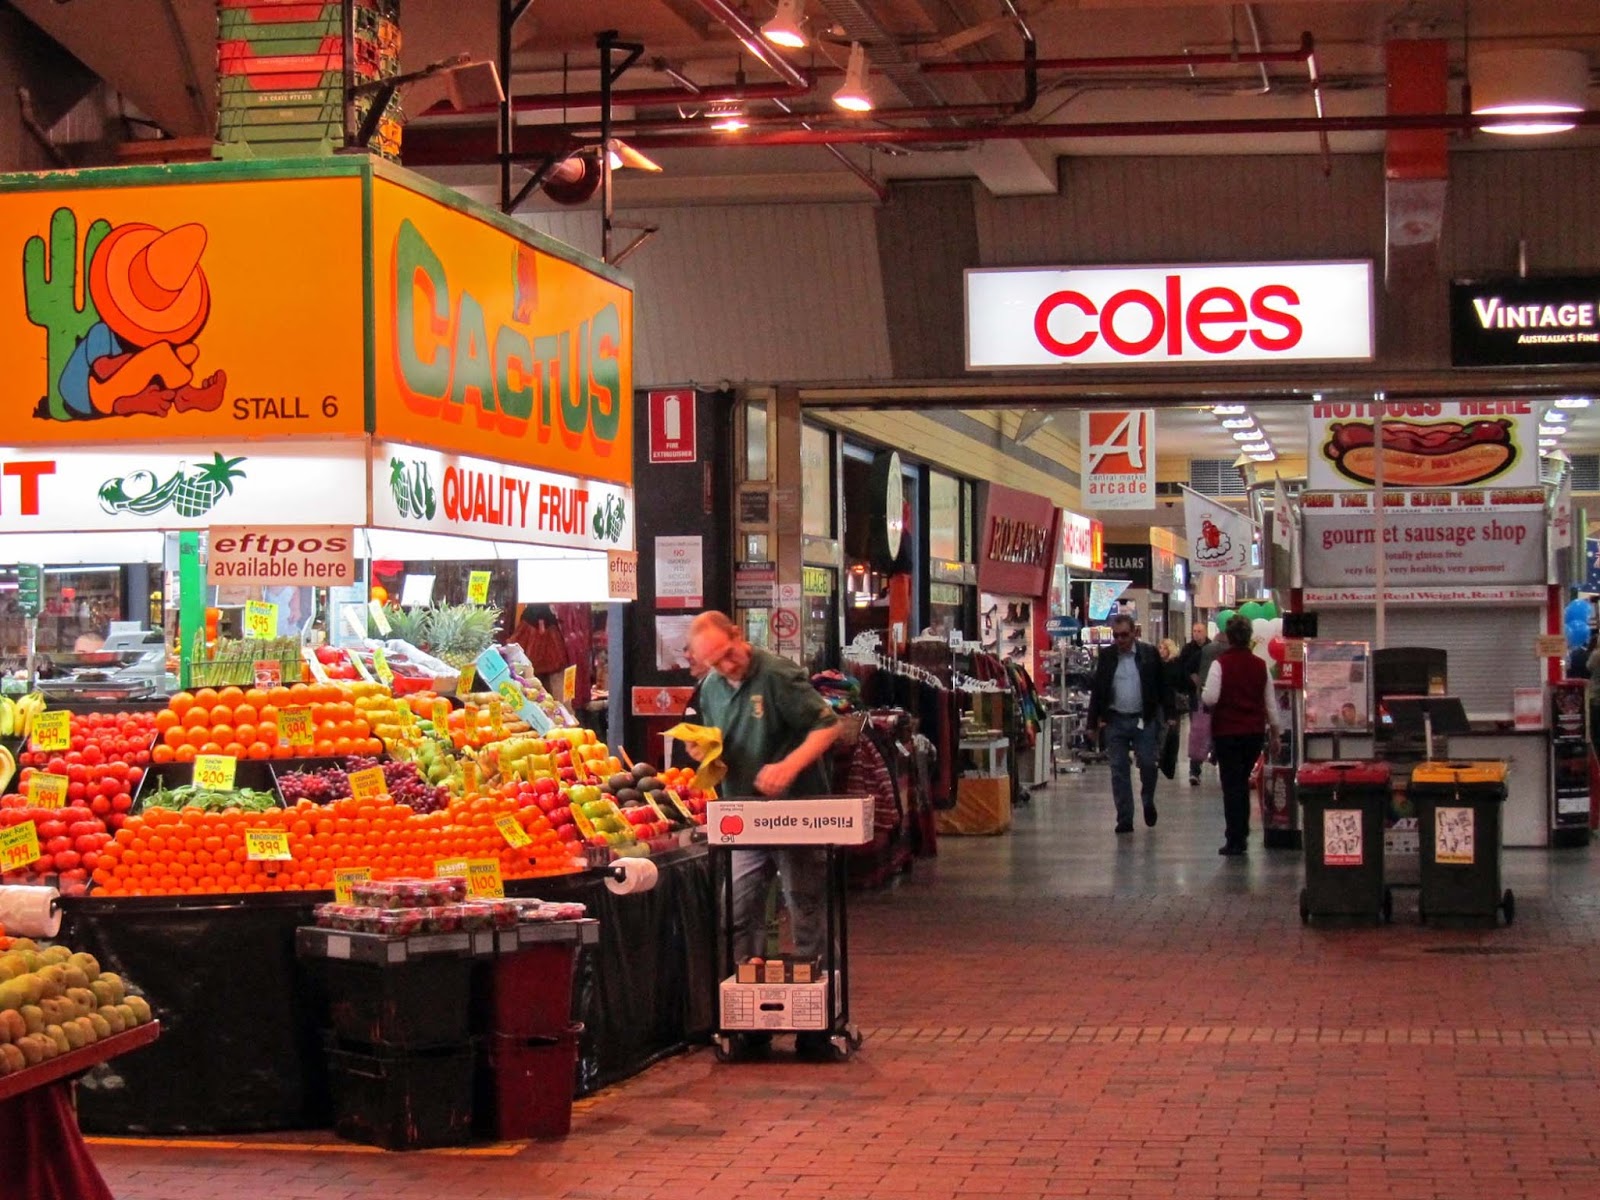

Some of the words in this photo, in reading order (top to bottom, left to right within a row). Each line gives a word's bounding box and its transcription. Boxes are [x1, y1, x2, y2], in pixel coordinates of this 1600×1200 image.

[1034, 275, 1303, 357] coles
[1473, 298, 1593, 328] VINTAGE
[390, 218, 622, 457] CACTUS
[232, 398, 309, 420] STALL
[321, 397, 338, 418] 6
[1313, 401, 1442, 418] HOTOGS
[653, 450, 692, 458] EXTINGUISHER
[1089, 481, 1147, 494] arcade
[443, 466, 530, 529] QUALITY
[538, 483, 589, 535] FRUIT
[1339, 493, 1368, 507] TAKE
[1410, 492, 1452, 507] GLUTEN
[1457, 491, 1485, 506] FREE
[1322, 526, 1398, 549] gourmet
[1404, 525, 1476, 546] sausage
[1482, 519, 1526, 544] shop
[215, 534, 348, 555] eftpos
[1415, 550, 1443, 560] gluten
[1446, 550, 1463, 559] free
[215, 557, 298, 577] available
[303, 557, 347, 577] here
[1389, 567, 1406, 575] very
[1410, 565, 1445, 574] healthy,
[1448, 565, 1466, 573] very
[1468, 564, 1505, 573] gourmet
[1383, 592, 1414, 600] Real
[754, 817, 798, 829] apples
[802, 817, 853, 828] Filsell's
